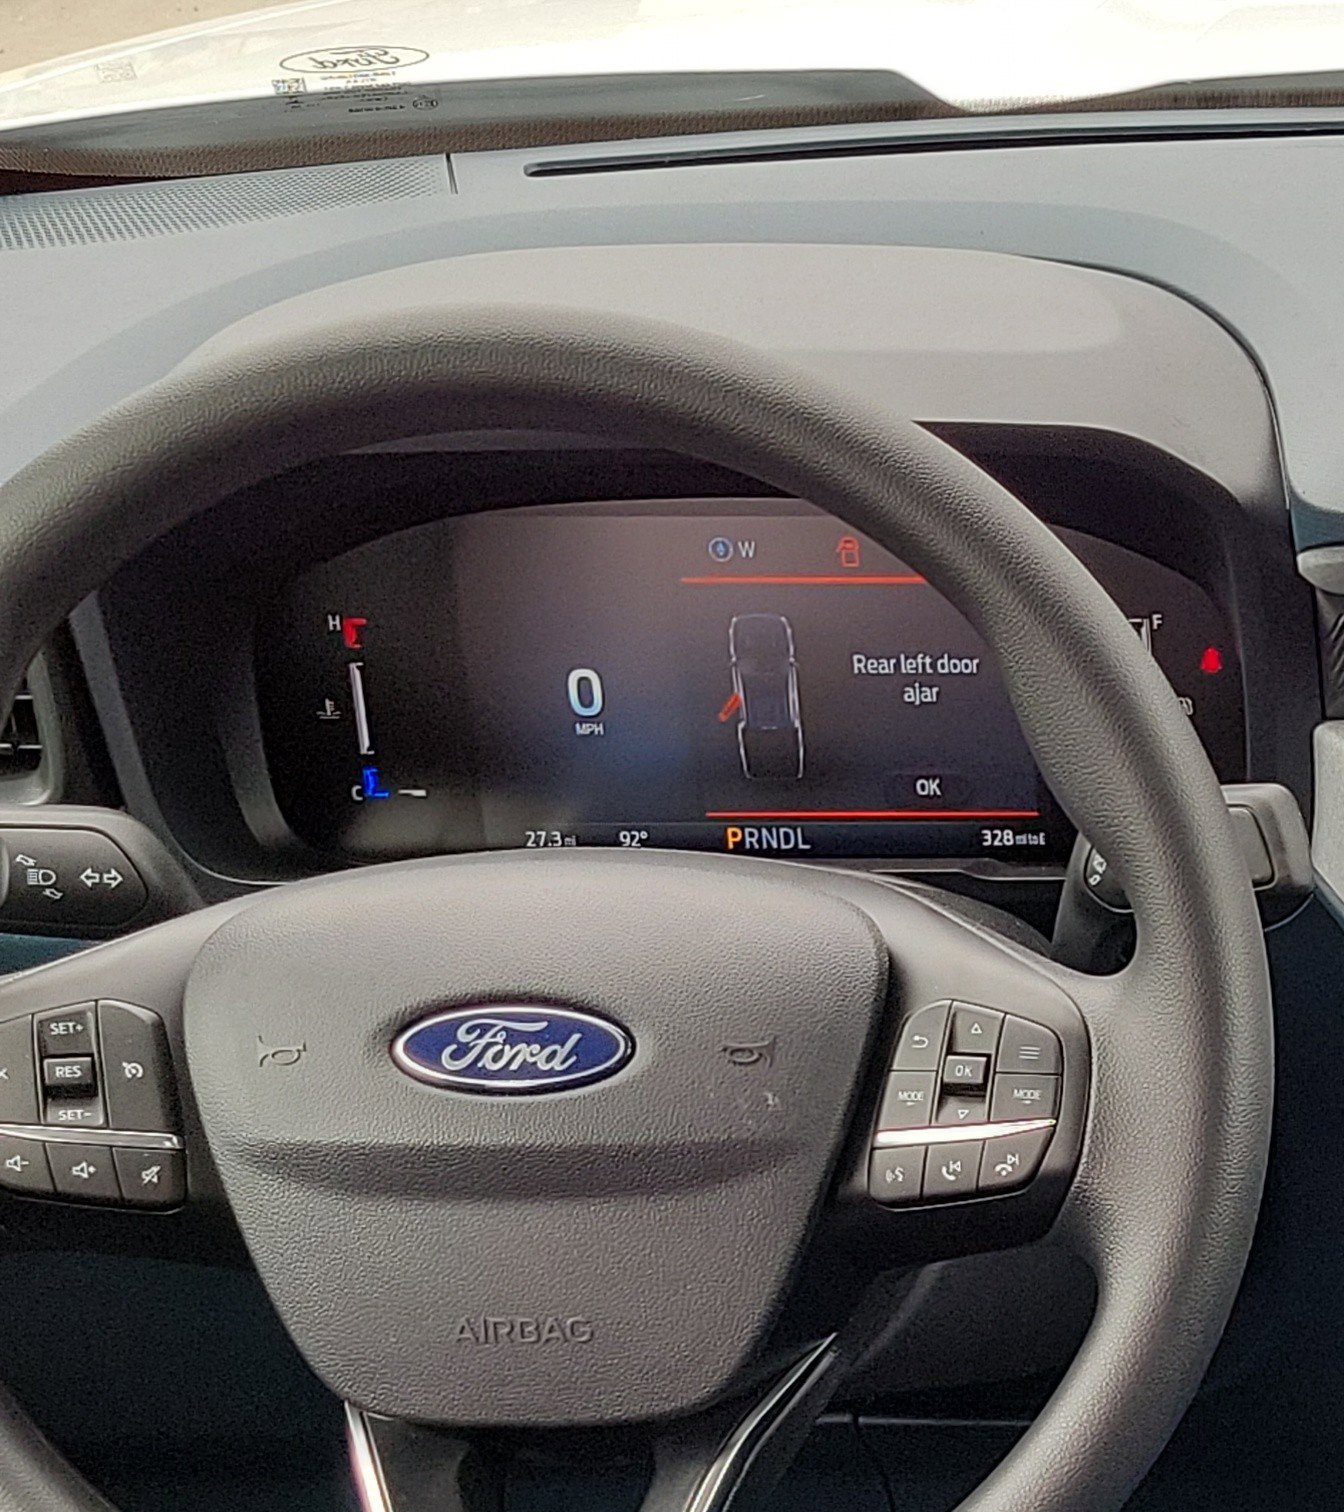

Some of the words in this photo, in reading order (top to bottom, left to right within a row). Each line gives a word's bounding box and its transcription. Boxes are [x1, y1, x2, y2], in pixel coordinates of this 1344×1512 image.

[738, 542, 755, 558] W
[328, 616, 341, 630] H
[1152, 614, 1162, 630] F
[852, 655, 895, 674] Rear
[901, 654, 933, 674] left
[936, 655, 979, 674] door
[567, 668, 604, 717] 0
[903, 683, 939, 705] ajar
[576, 723, 604, 736] MPH
[352, 786, 363, 801] C
[916, 778, 941, 797] OK
[525, 831, 562, 847] 27.3
[619, 831, 648, 847] 92°
[981, 829, 1014, 846] 328
[50, 1021, 84, 1035] SET+
[441, 1019, 580, 1072] Ford
[55, 1066, 82, 1078] RES
[955, 1065, 972, 1077] OK
[898, 1091, 925, 1101] MODE
[1013, 1089, 1042, 1100] MODE
[456, 1317, 595, 1345] AIRBAG
